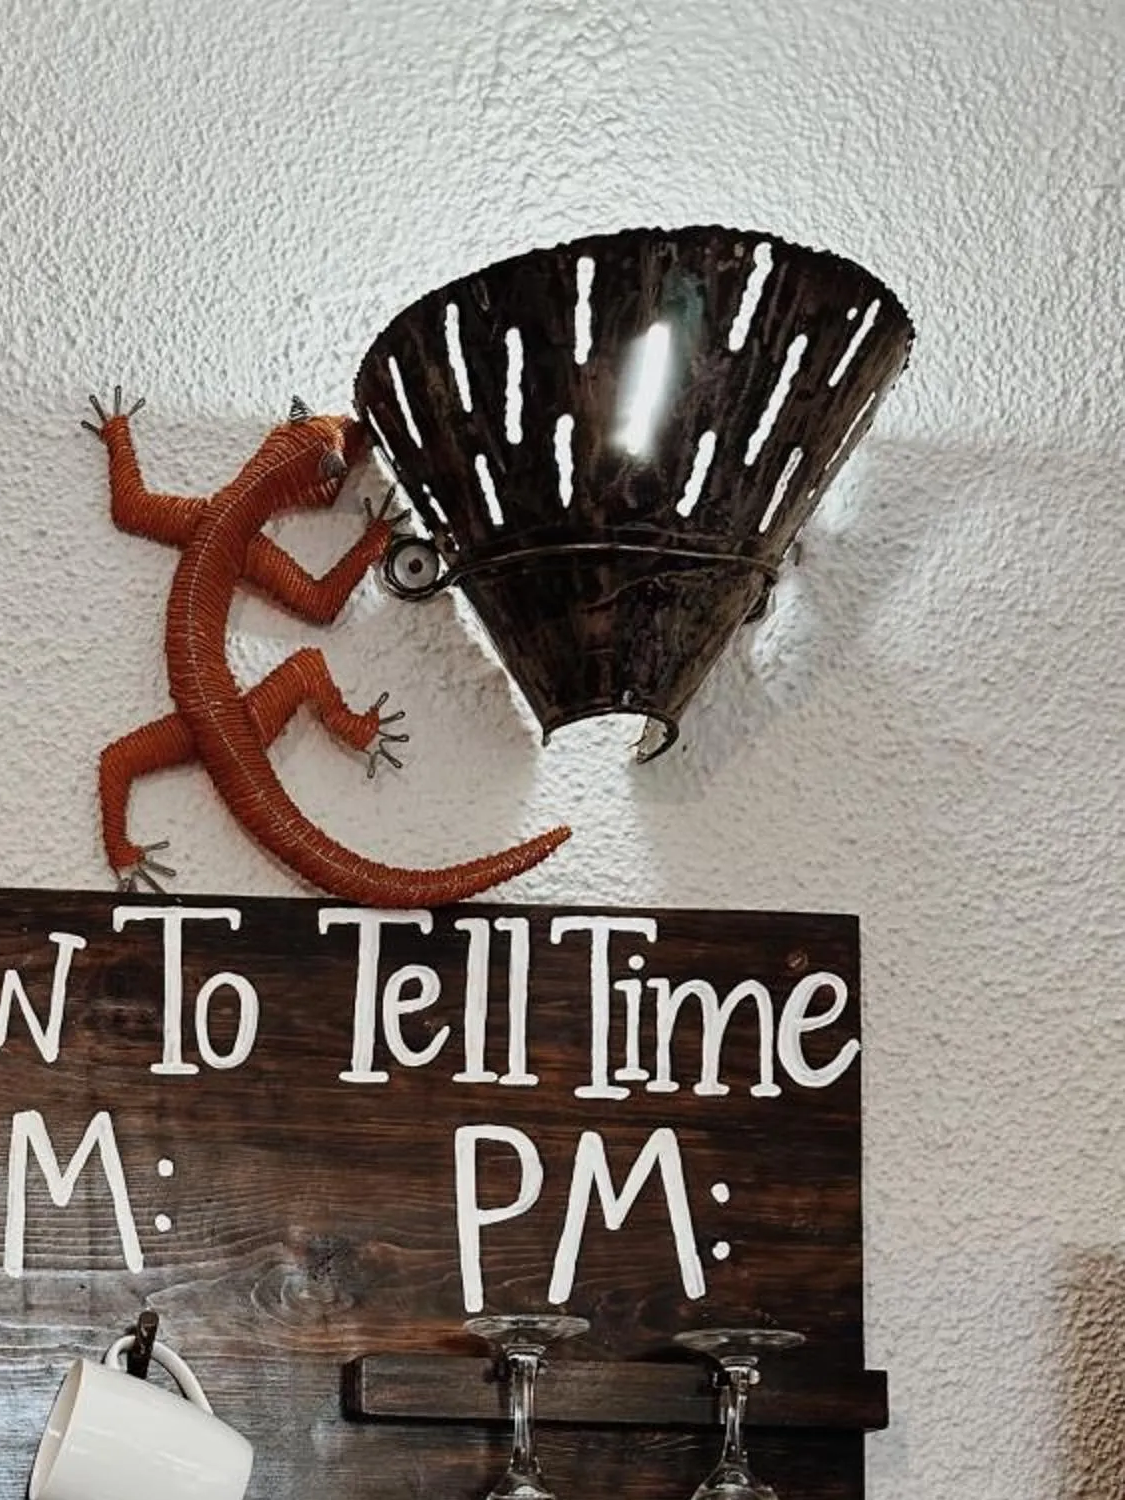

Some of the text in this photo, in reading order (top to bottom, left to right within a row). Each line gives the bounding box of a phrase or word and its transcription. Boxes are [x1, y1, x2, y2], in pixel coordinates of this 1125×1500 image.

[113, 906, 258, 1075] To
[318, 908, 539, 1086] Tell
[550, 915, 861, 1100] Time
[454, 1125, 730, 1313] PM:
